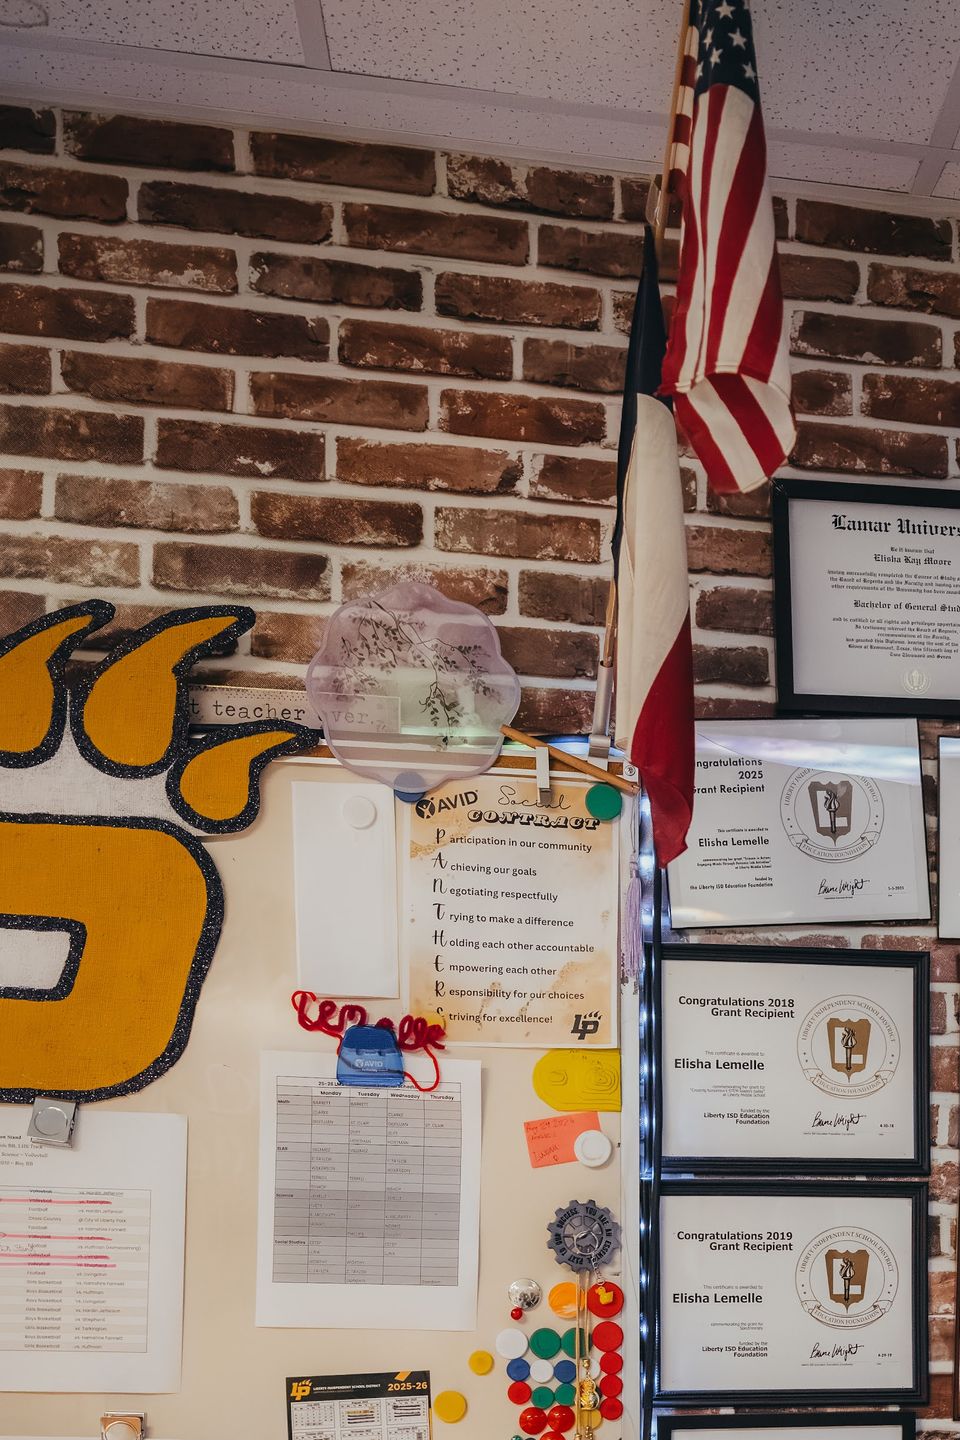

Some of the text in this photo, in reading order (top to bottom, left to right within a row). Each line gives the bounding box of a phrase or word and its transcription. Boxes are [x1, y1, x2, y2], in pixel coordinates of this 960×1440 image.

[832, 514, 891, 532] Lamar
[874, 553, 901, 563] Elisha
[924, 557, 951, 566] Moore
[853, 599, 891, 609] Bachelor
[905, 602, 937, 611] General
[213, 700, 305, 721] teacher
[697, 757, 762, 769] ngratulations
[738, 770, 763, 779] 2025
[720, 784, 764, 795] Recipient
[437, 790, 478, 813] AVID
[467, 809, 600, 830] CONTRACT
[449, 834, 506, 846] articipation
[509, 838, 517, 846] in
[538, 842, 592, 853] community
[699, 836, 769, 847] Elisha Lemelle
[432, 852, 448, 869] A
[450, 863, 491, 875] chieving
[512, 868, 537, 877] goals
[449, 887, 499, 899] egotiating
[501, 891, 558, 903] respectfully
[433, 903, 444, 920] T
[450, 913, 474, 924] rying
[489, 916, 515, 924] make
[525, 917, 574, 927] difference
[434, 930, 594, 952] H olding each other accountable
[449, 965, 503, 975] mpowering
[506, 966, 528, 974] each
[530, 967, 557, 975] other
[435, 980, 446, 997] R
[449, 989, 511, 1000] esponsibility
[513, 990, 527, 998] for
[548, 991, 585, 1000] choices
[679, 996, 794, 1008] Congratulations 2018
[449, 1012, 552, 1023] triving for excellence!
[711, 1007, 795, 1019] Grant Recipient
[570, 1014, 600, 1040] LP
[675, 1058, 764, 1070] Elisha Lemelle
[390, 1093, 420, 1101] Wednesday
[585, 1206, 598, 1216] YOU
[597, 1214, 610, 1226] ARE
[677, 1231, 793, 1242] Congratulations 2019
[709, 1242, 793, 1253] Grant Recipient
[673, 1293, 762, 1303] Elisha Lemelle
[290, 1382, 312, 1400] LP
[388, 1382, 427, 1391] 2025-26
